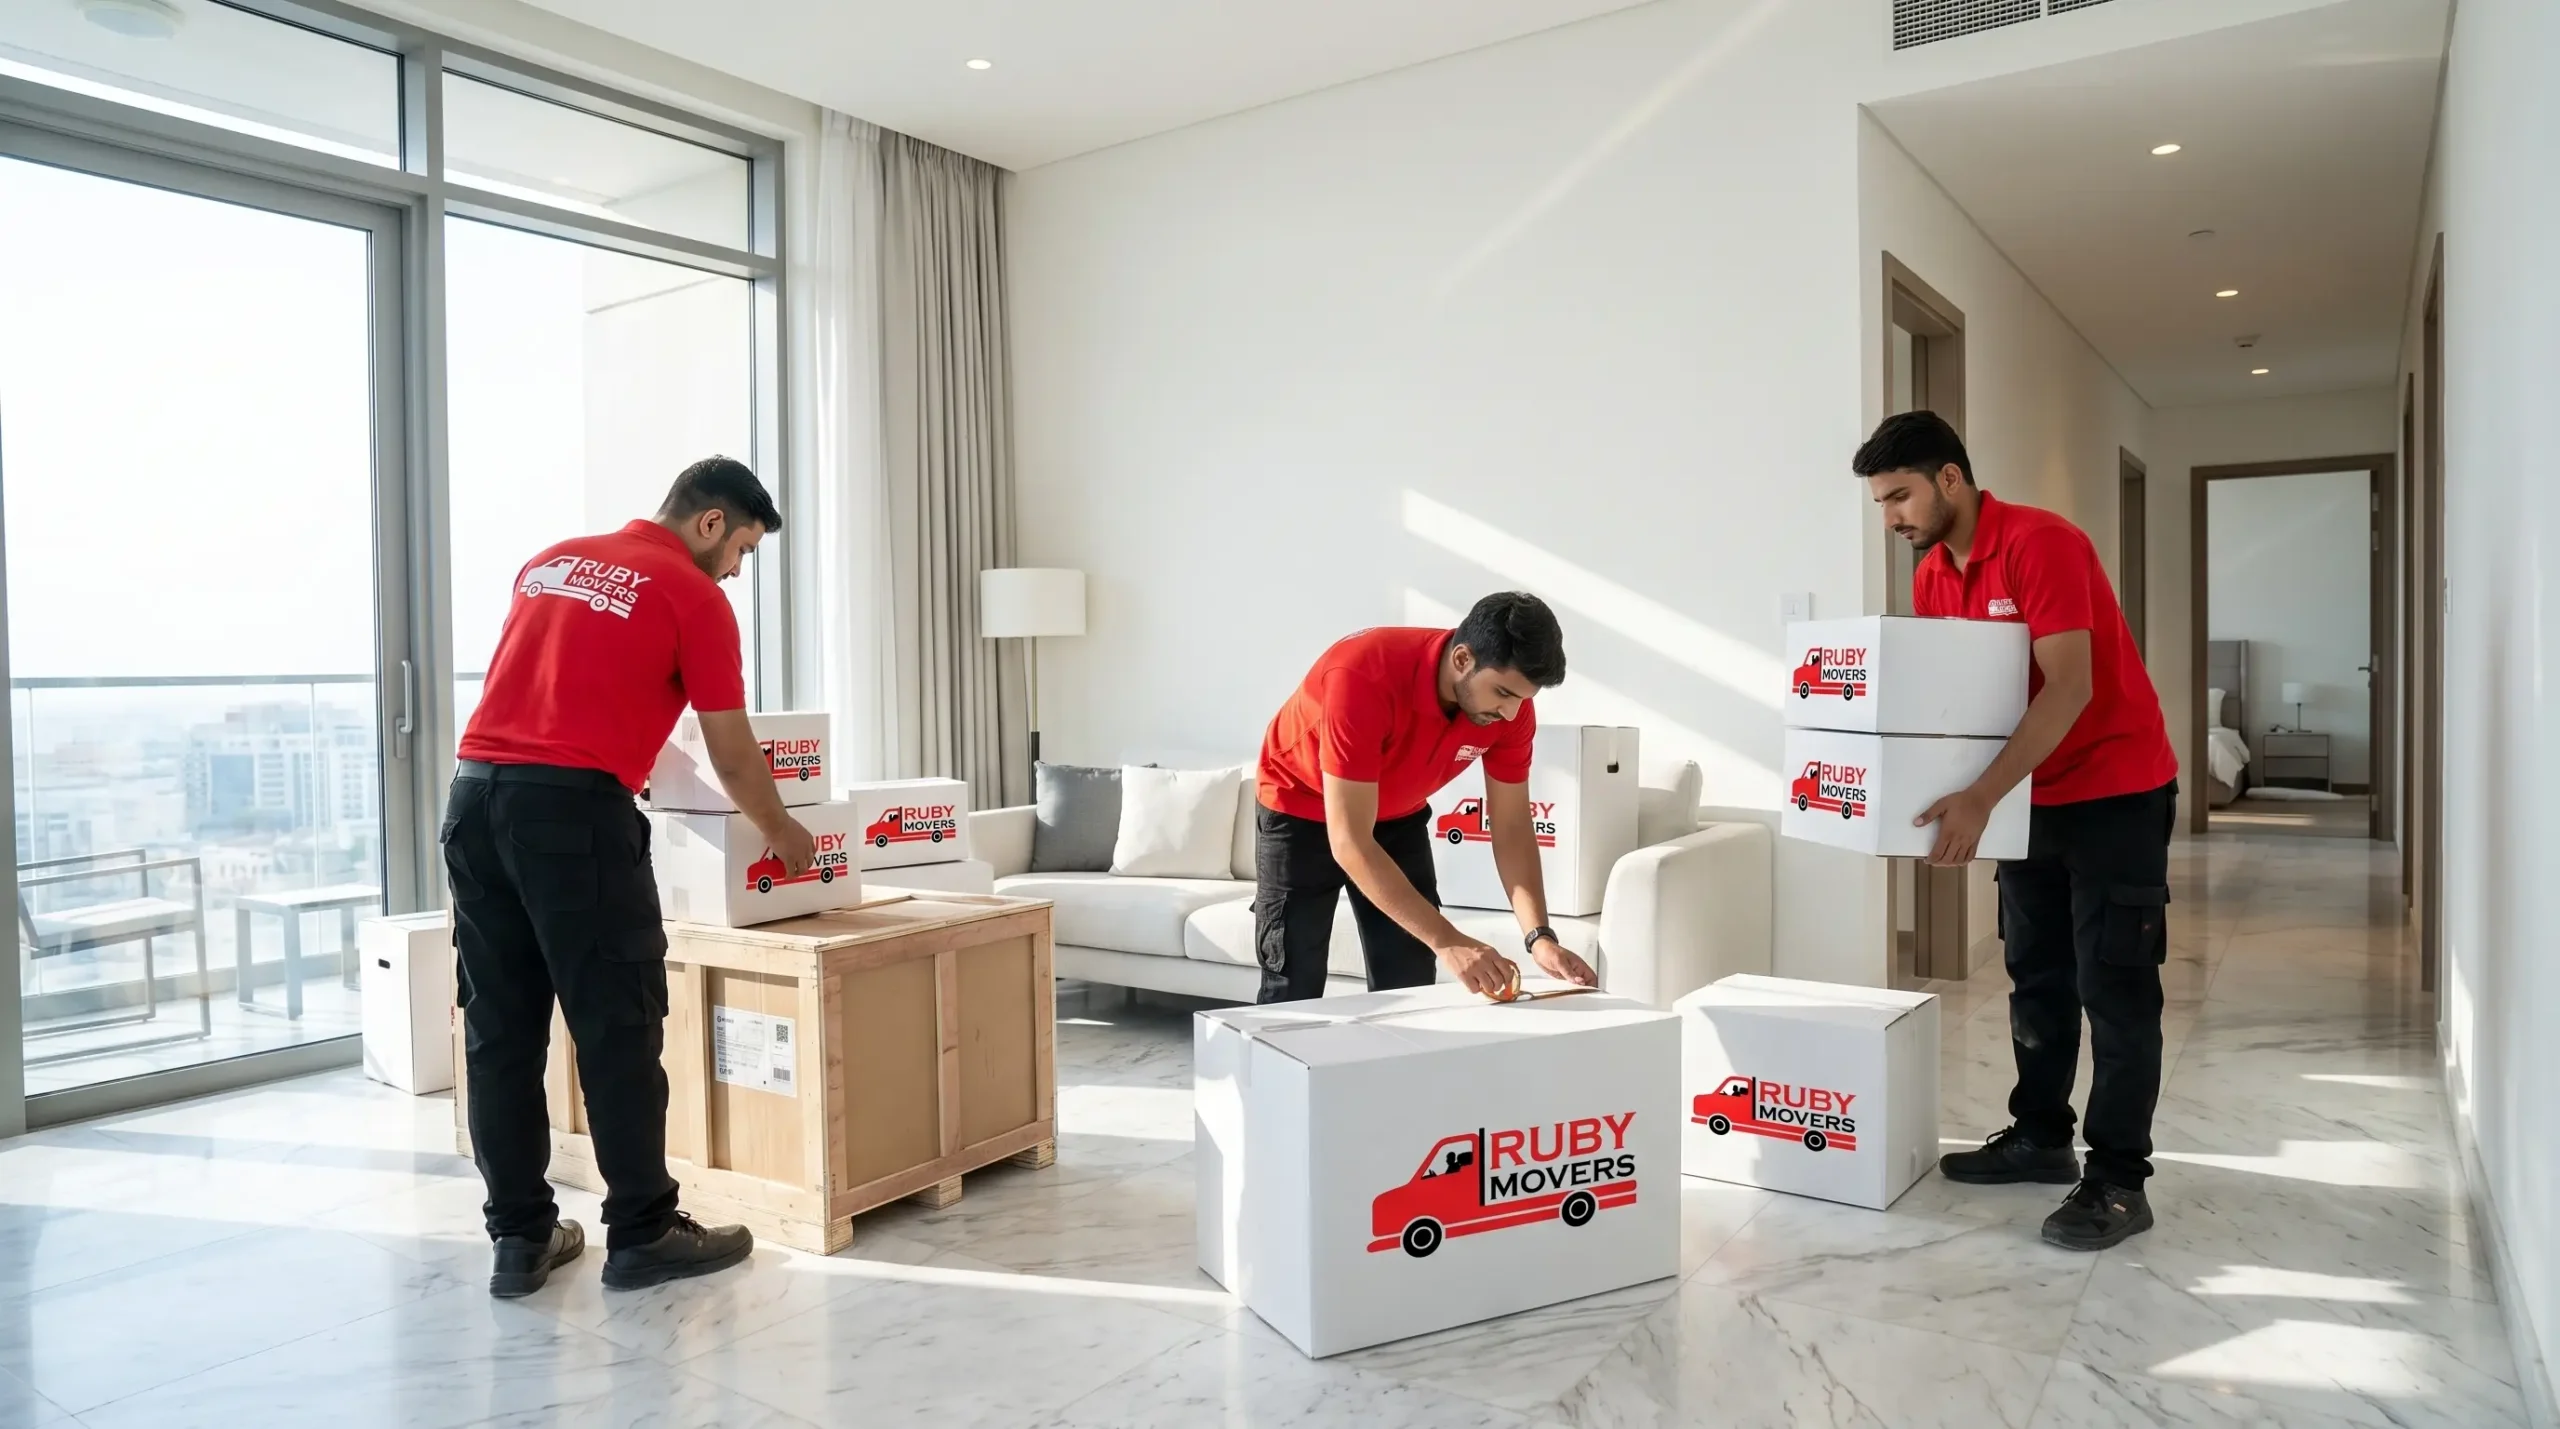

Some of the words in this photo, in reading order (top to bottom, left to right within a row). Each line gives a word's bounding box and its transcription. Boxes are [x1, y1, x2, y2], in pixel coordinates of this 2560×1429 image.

[575, 559, 652, 588] RUBY
[568, 575, 639, 604] MOVERS
[1823, 648, 1867, 666] RUBY
[1822, 669, 1866, 681] MOVERS
[776, 739, 820, 755] RUBY
[775, 755, 821, 768] MOVERS
[1822, 764, 1867, 786] RUBY
[1821, 784, 1867, 802] MOVERS
[904, 805, 955, 820] RUBY
[904, 819, 956, 832] MOVERS
[814, 852, 848, 867] VERS
[1759, 1080, 1857, 1115] RUBY
[1759, 1104, 1856, 1133] MOVERS
[1490, 1111, 1637, 1170] RUBY
[1490, 1154, 1636, 1200] MOVERS
